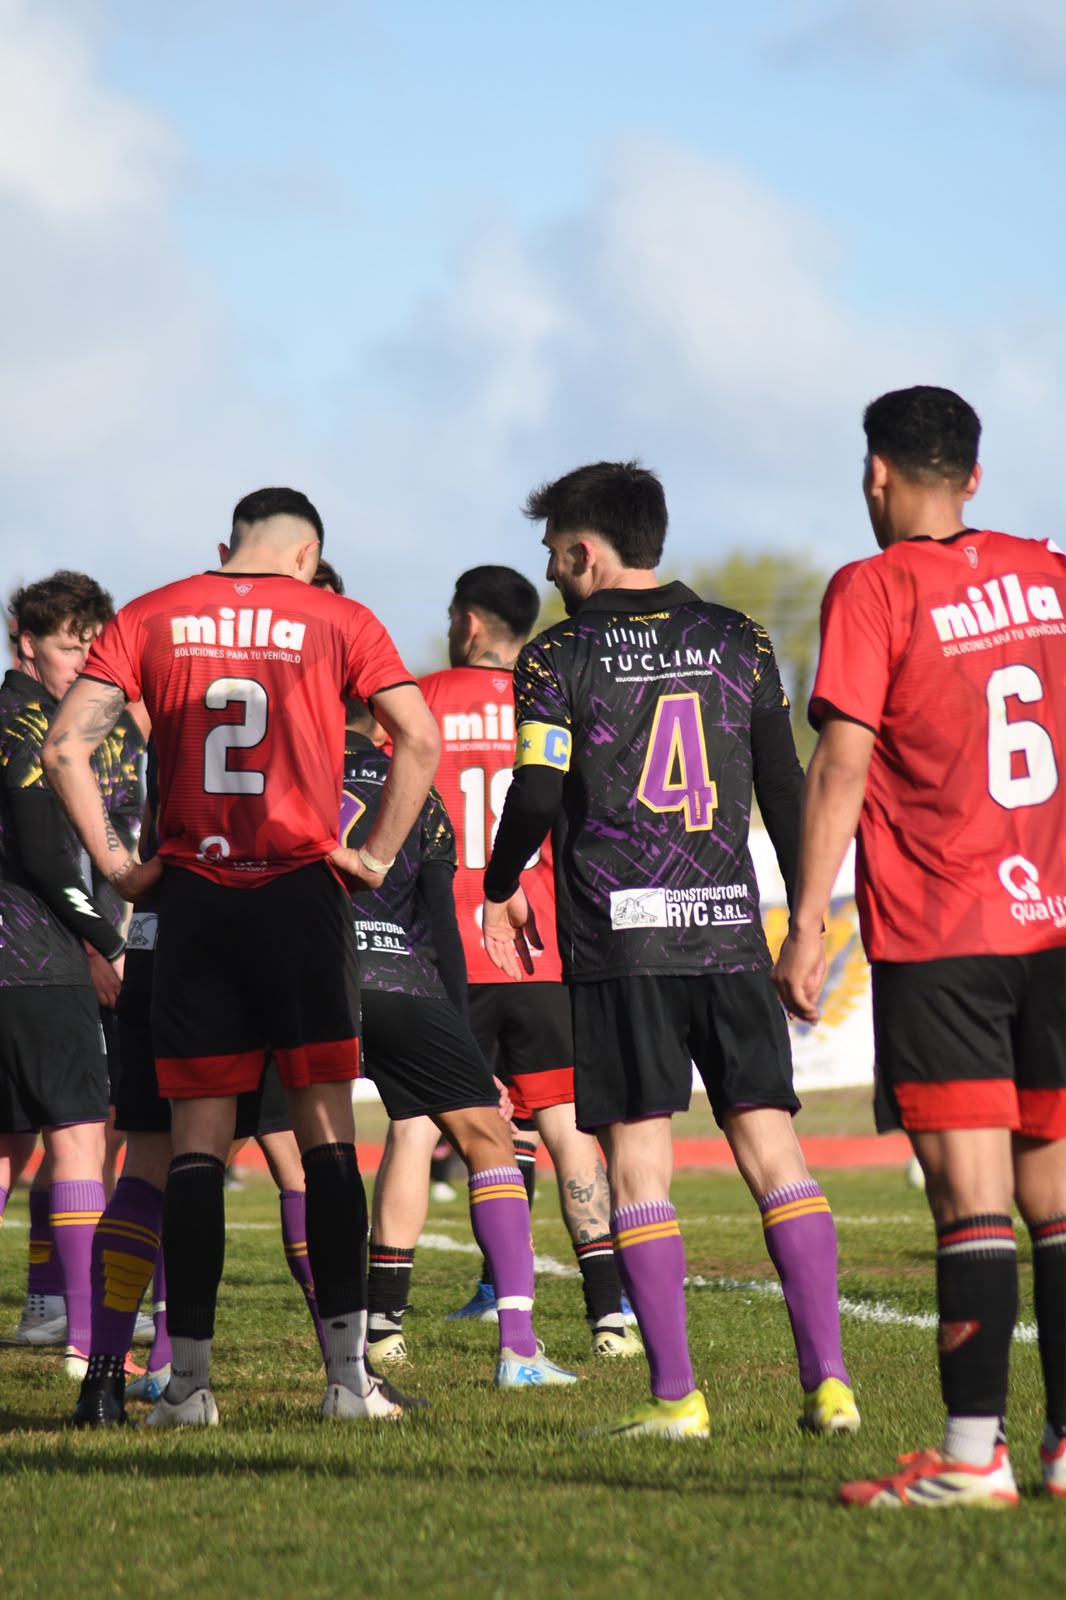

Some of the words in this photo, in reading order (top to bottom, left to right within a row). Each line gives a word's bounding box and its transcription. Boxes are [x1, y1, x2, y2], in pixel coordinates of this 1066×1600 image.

[930, 573, 1064, 642] milla
[171, 607, 306, 651] milla
[1011, 628, 1025, 641] TU
[174, 647, 225, 659] SOLUCIONES
[227, 650, 249, 660] PARA
[251, 651, 261, 660] TU
[263, 650, 301, 664] VEHÍCULO
[203, 676, 269, 796] 2
[443, 703, 514, 741] mil
[986, 663, 1058, 810] 6
[543, 729, 568, 765] C
[637, 692, 718, 832] 4
[665, 884, 748, 903] CONSTRUCTORA
[354, 920, 406, 936] TRUCTORA
[666, 902, 709, 927] RYC
[713, 904, 747, 920] S.R.L.
[1010, 895, 1066, 927] quali
[374, 935, 405, 950] S.R.L.
